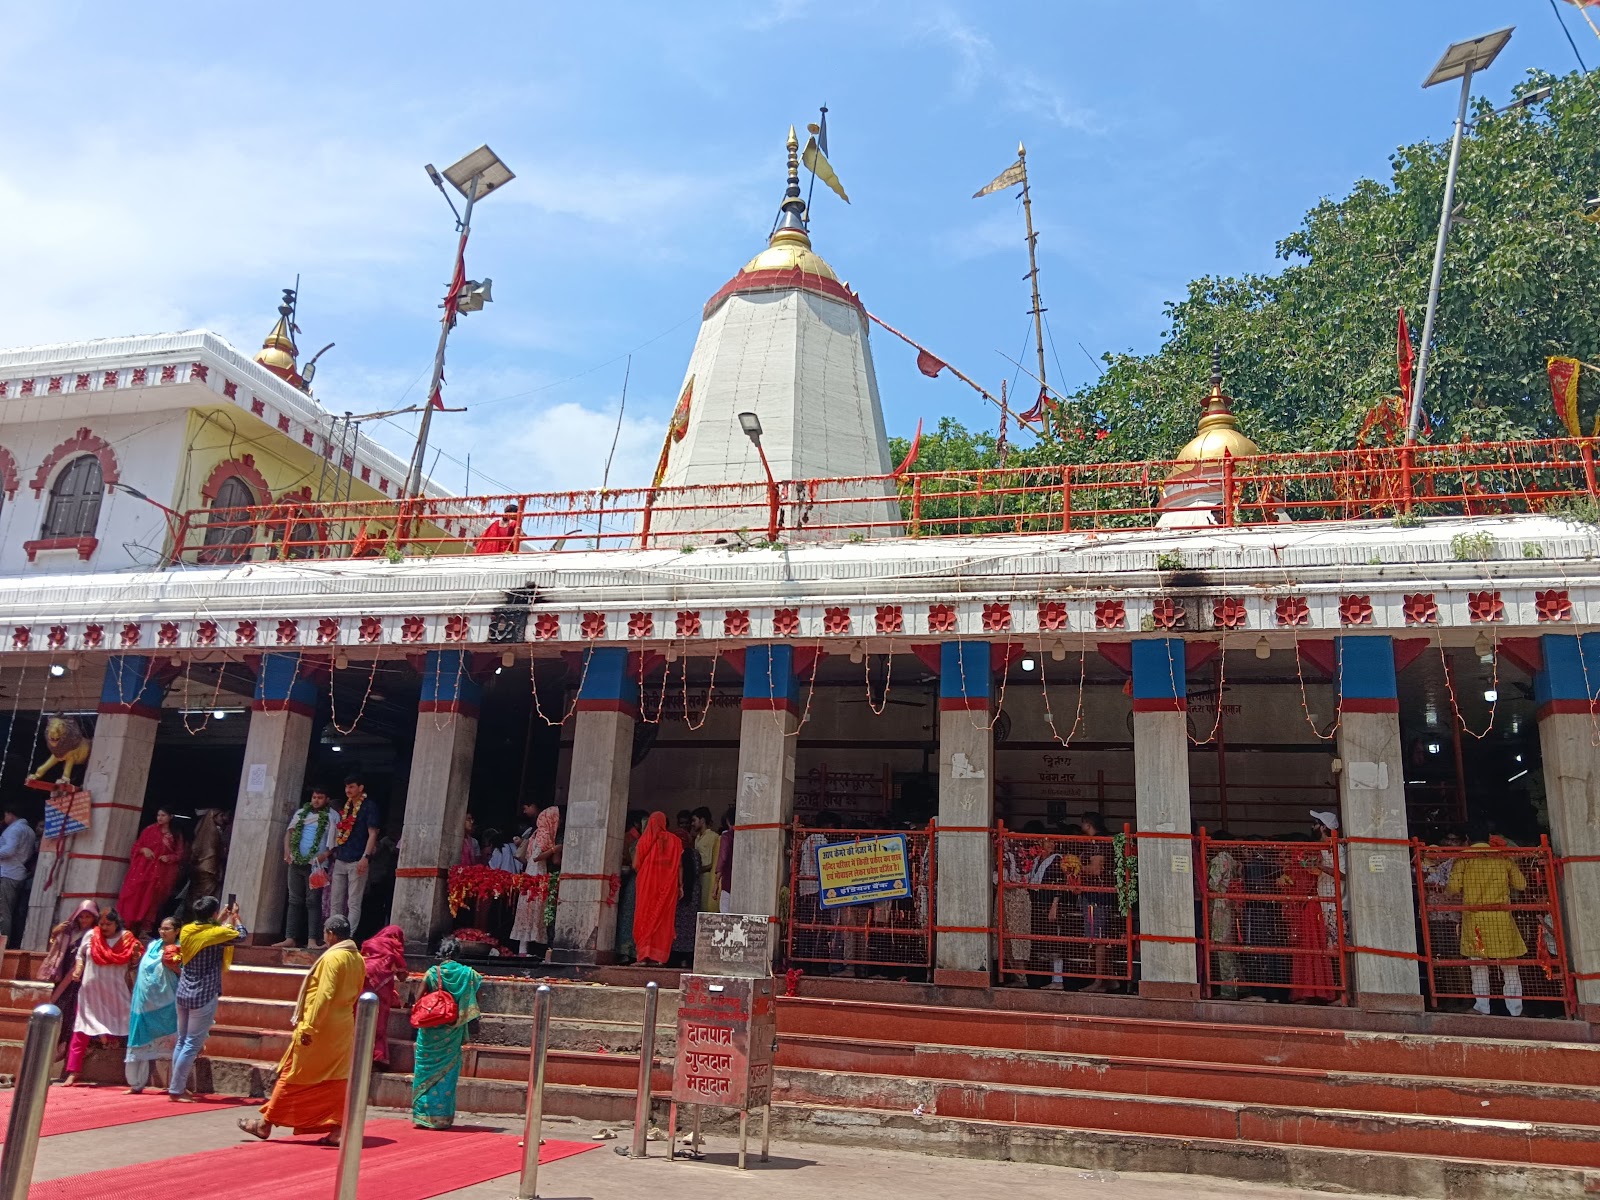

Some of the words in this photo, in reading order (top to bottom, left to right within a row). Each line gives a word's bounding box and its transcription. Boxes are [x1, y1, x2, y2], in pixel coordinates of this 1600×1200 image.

[822, 850, 833, 859] आप
[840, 884, 872, 894] इंडियन
[687, 1024, 735, 1047] दानपात्र
[685, 1051, 734, 1074] गुप्तदान
[685, 1074, 732, 1096] महादान
